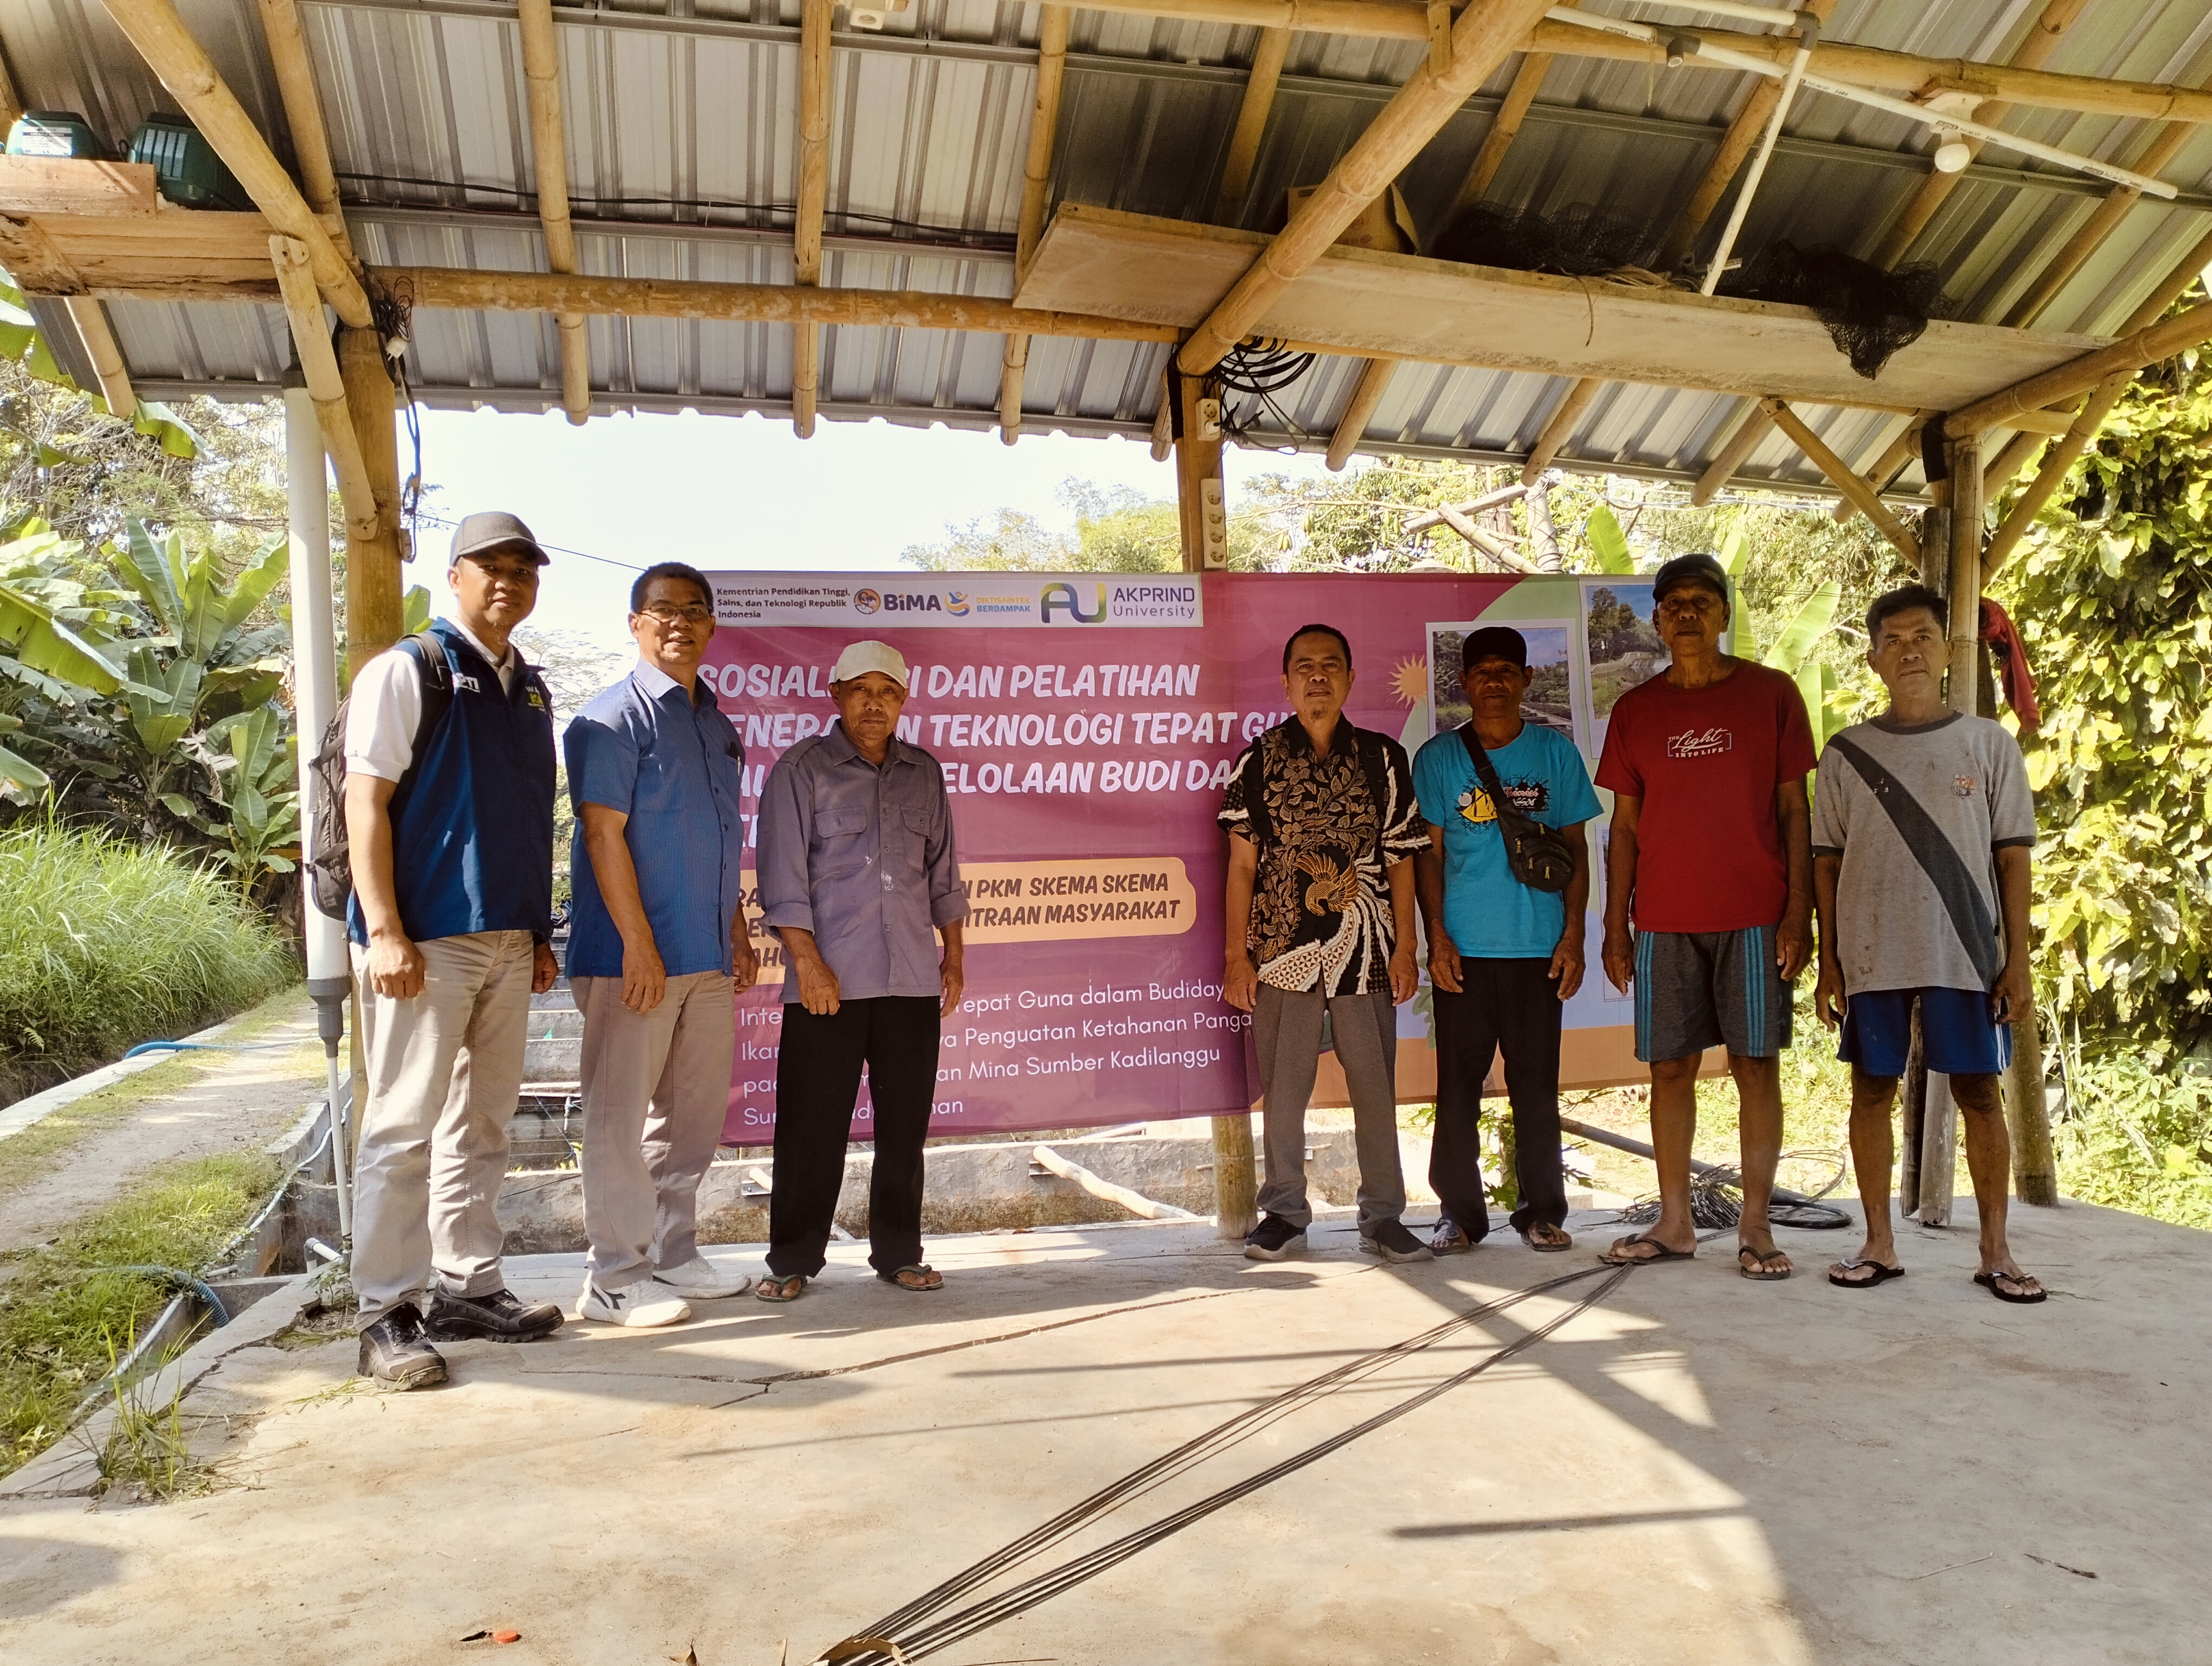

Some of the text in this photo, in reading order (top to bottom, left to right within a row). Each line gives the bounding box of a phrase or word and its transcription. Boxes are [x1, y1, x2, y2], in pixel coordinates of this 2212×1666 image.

[771, 587, 820, 595] Pendidikan
[1114, 587, 1195, 603] AKPRIND
[764, 599, 807, 608] Teknologi
[809, 599, 846, 609] Republik
[1114, 605, 1195, 619] University
[928, 664, 1004, 699] DAN
[1009, 664, 1200, 698] PELATIHAN
[930, 713, 1124, 747] TEKNOLOGI
[1131, 712, 1238, 744] TEPAT
[1671, 728, 1728, 753] Light
[1701, 747, 1724, 755] LIFE
[1101, 760, 1181, 792] BUDI
[976, 877, 1022, 899] PKM
[1030, 875, 1097, 896] SKEMA
[1102, 873, 1168, 894] SKEMA
[1044, 899, 1180, 924] MASYARAKAT
[1018, 990, 1073, 1009] Guna
[1080, 983, 1142, 1006] dalam
[1149, 978, 1224, 1002] Budiday
[964, 1024, 1076, 1049] Penguatan
[1083, 1015, 1187, 1038] Ketahanan
[1194, 1012, 1252, 1033] Panga
[968, 1059, 1019, 1080] Mina
[1026, 1053, 1104, 1075] Sumber
[1111, 1046, 1221, 1069] Kadilanggu
